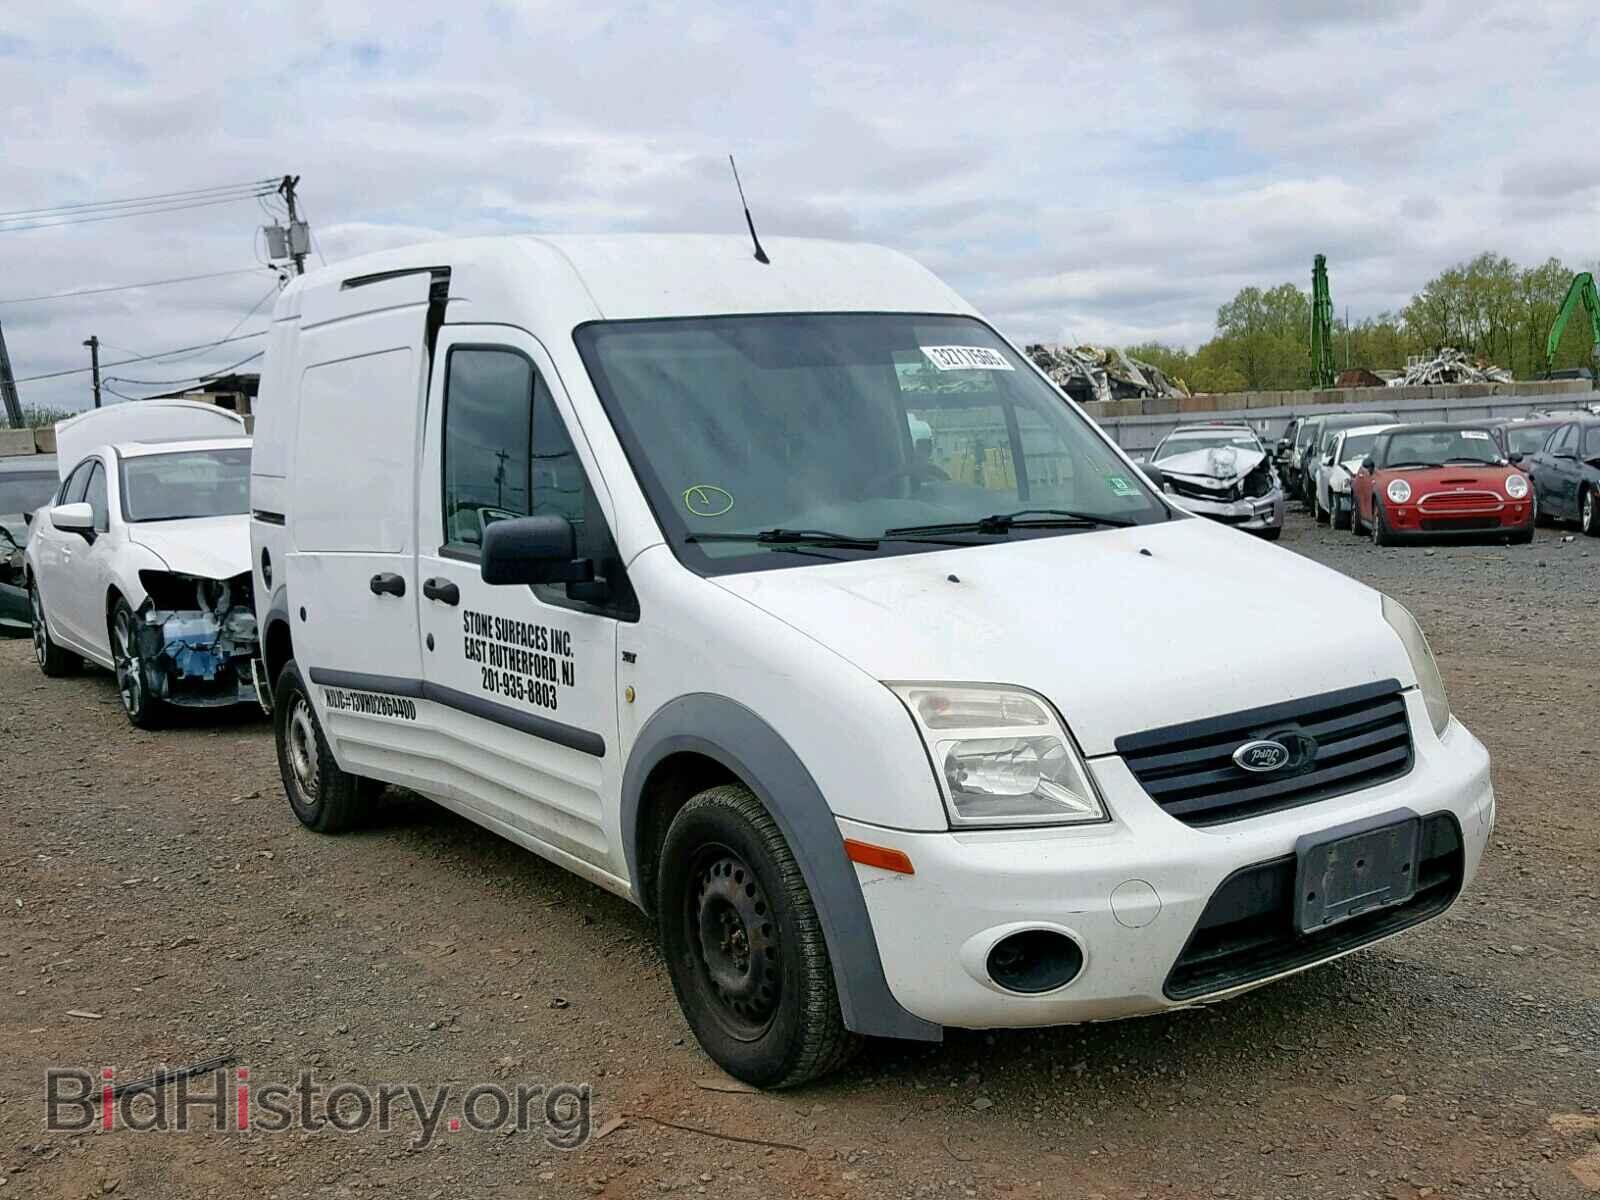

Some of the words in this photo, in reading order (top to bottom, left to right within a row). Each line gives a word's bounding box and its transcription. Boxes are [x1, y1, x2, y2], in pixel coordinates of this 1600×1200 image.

[464, 610, 493, 638] STONE
[494, 616, 548, 651] SURFACES
[550, 628, 574, 658] INC.
[464, 637, 486, 664] EAST
[489, 642, 560, 686] RUTHERFORD,
[561, 660, 575, 687] NJ
[481, 667, 558, 710] 201-935-8803
